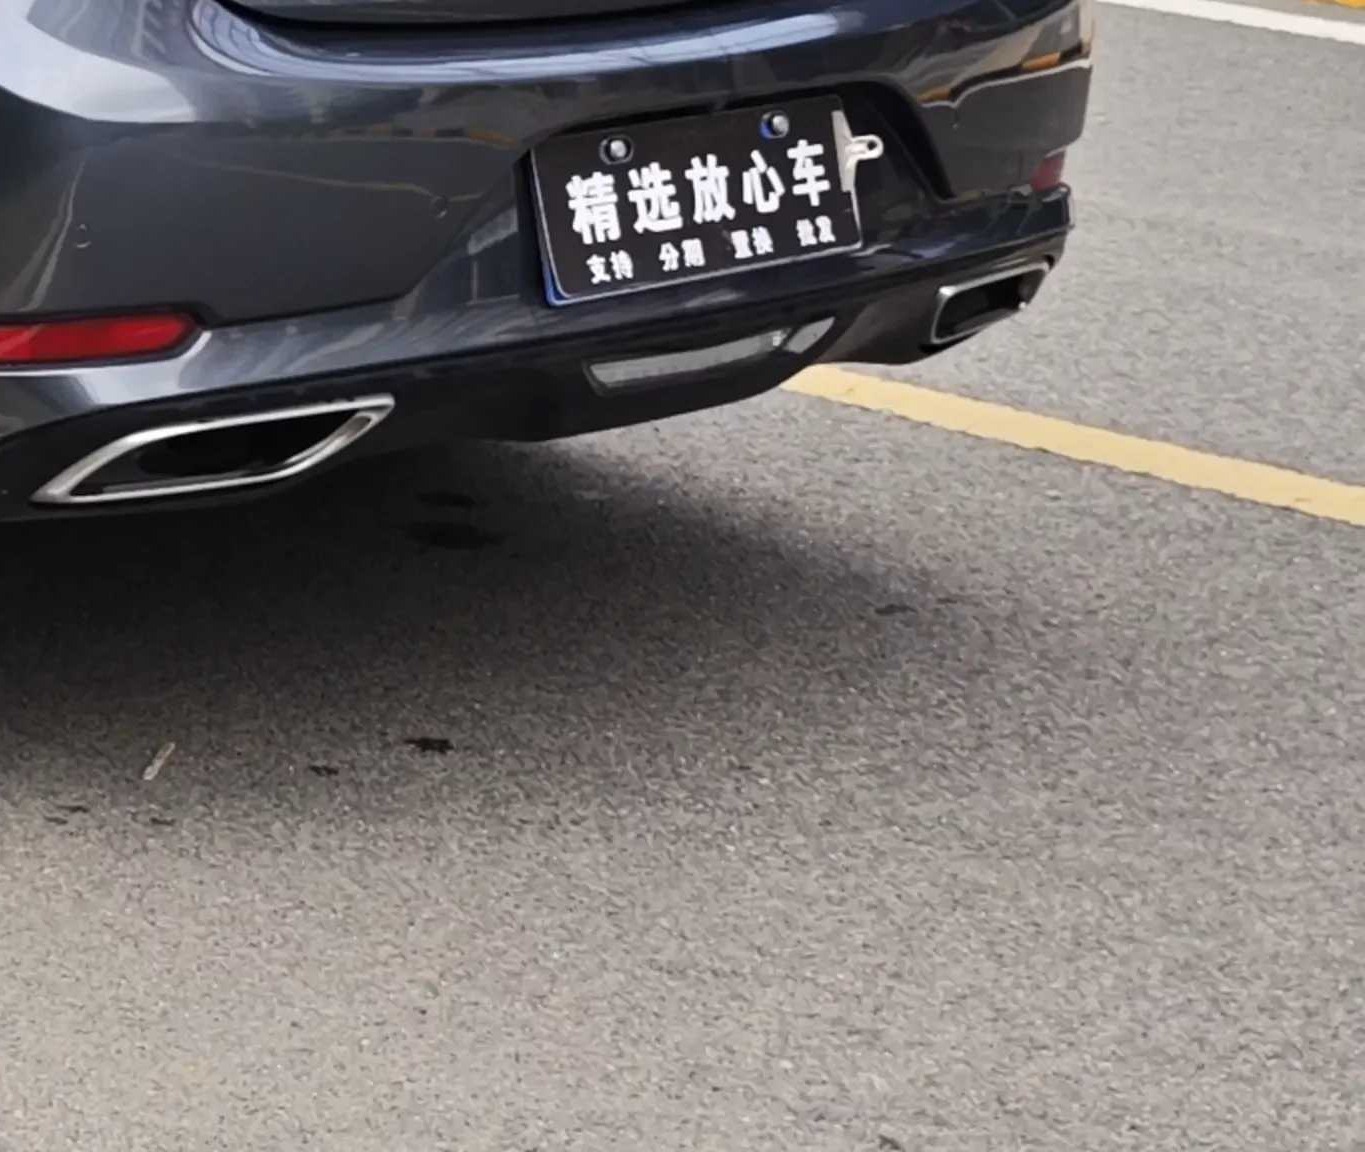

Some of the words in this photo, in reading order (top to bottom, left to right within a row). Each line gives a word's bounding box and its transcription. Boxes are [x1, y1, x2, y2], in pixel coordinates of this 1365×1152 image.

[566, 139, 831, 244] 精选放心车
[586, 249, 634, 284] 支持
